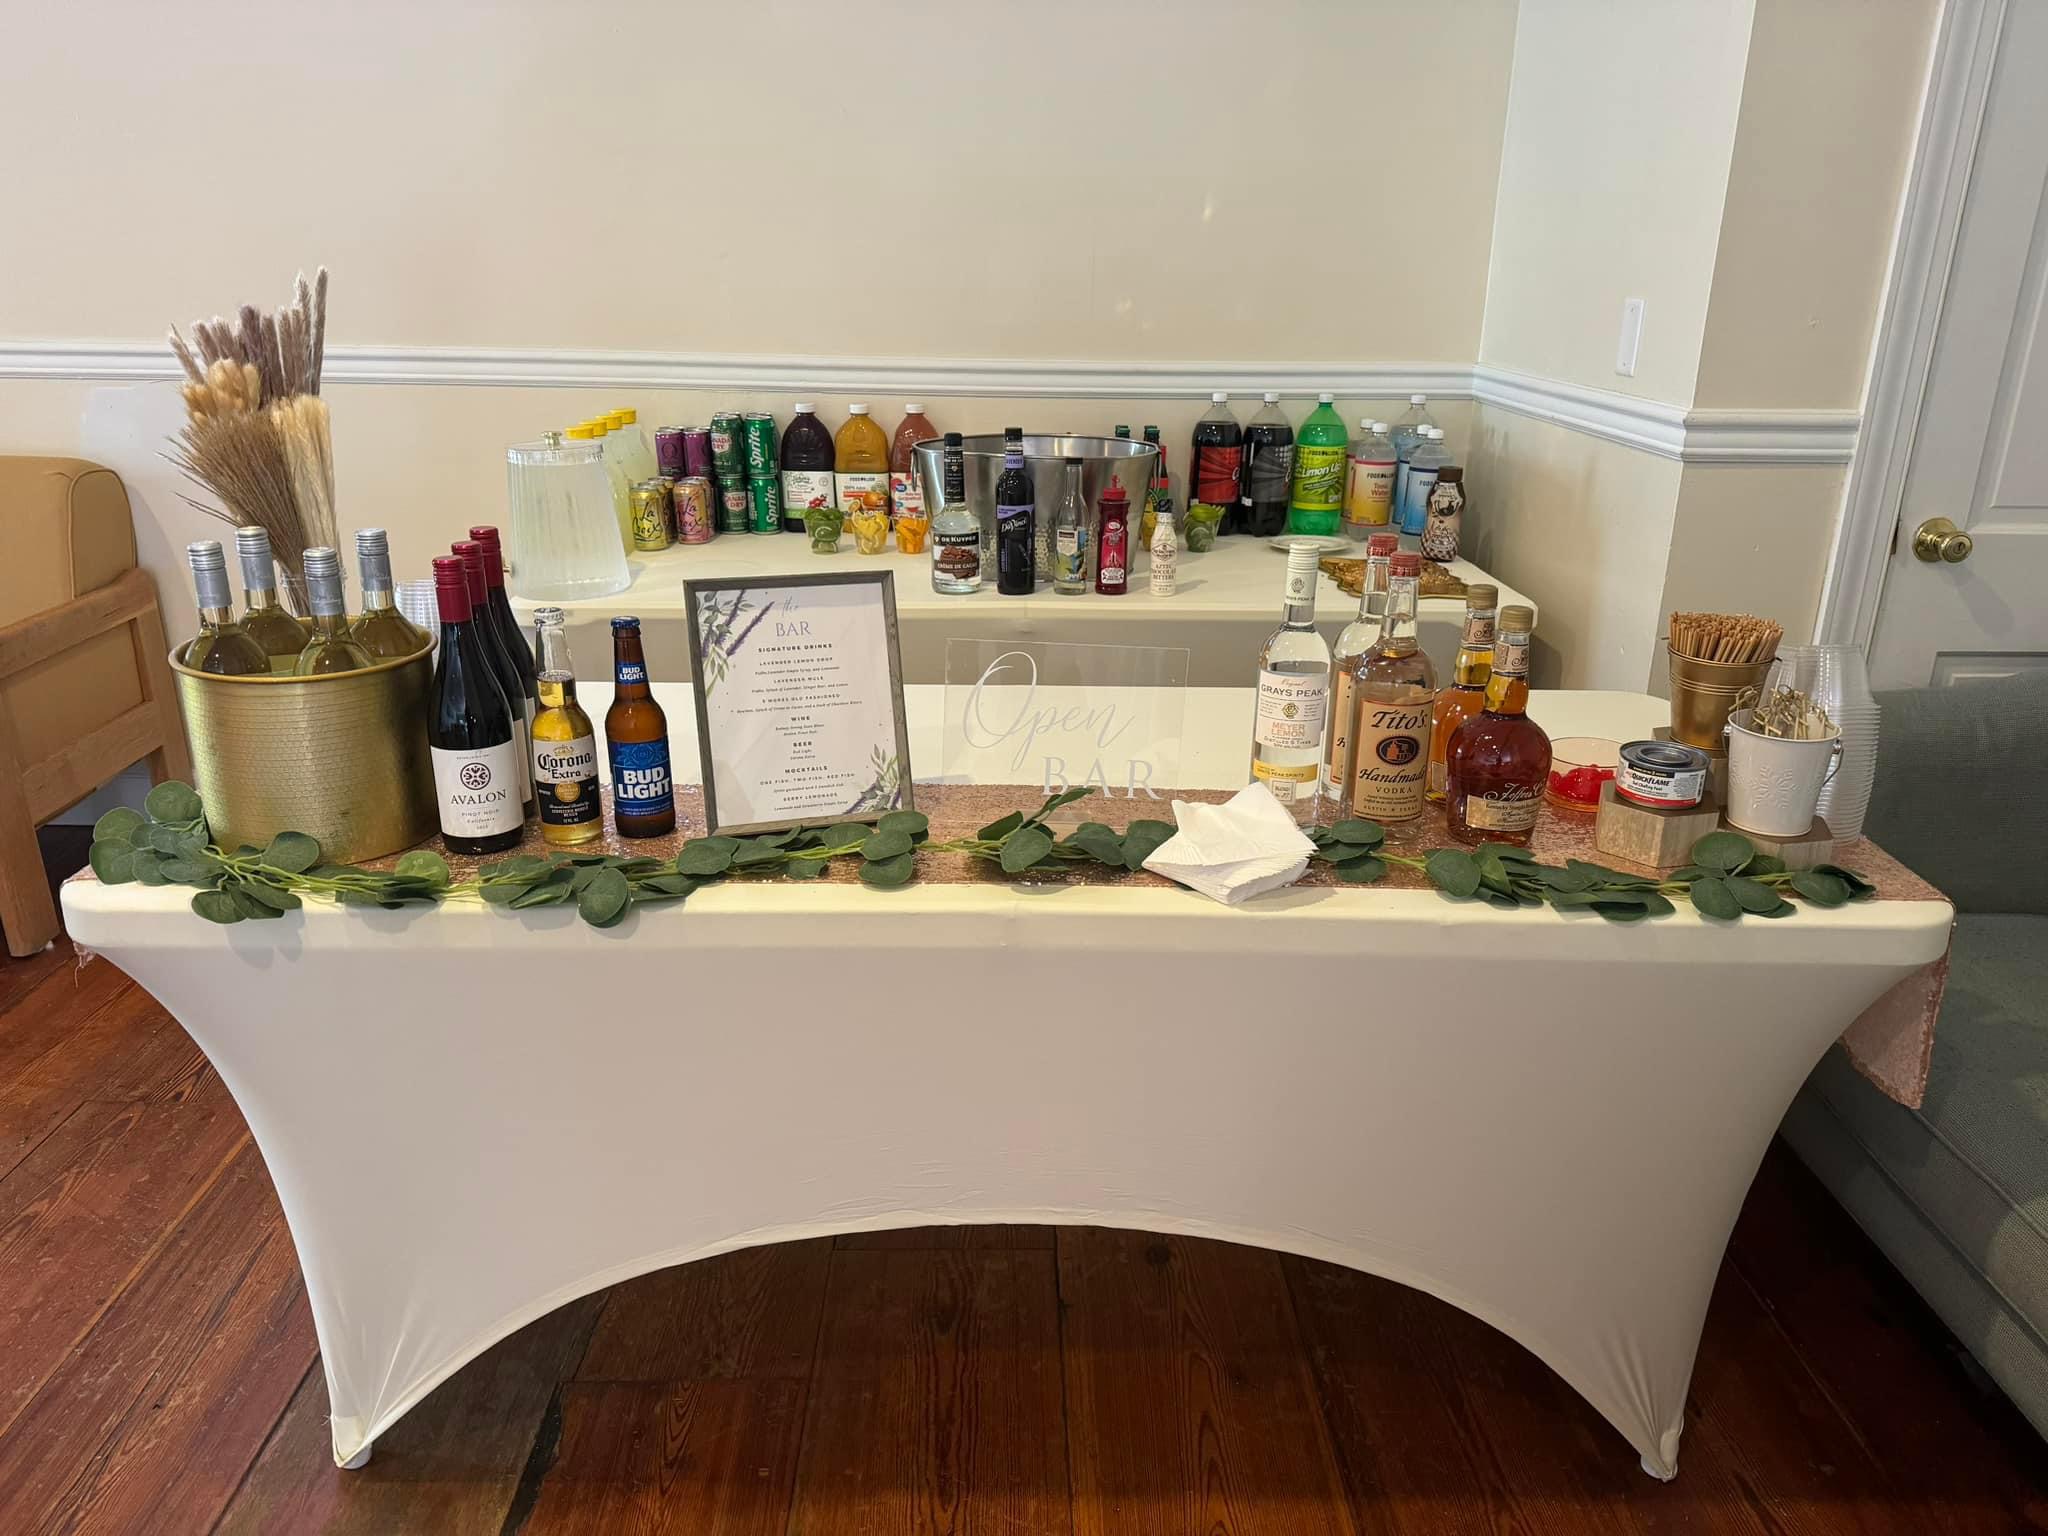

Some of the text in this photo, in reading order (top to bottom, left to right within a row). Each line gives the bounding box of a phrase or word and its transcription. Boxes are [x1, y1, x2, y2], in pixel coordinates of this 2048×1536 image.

[749, 427, 765, 468] Sprite
[766, 486, 781, 525] Sprite
[776, 620, 811, 637] BAR
[758, 645, 802, 653] SIGNATURE
[619, 671, 647, 682] LIGHT
[622, 667, 642, 675] BUD
[1261, 683, 1323, 698] GRAYS PEAK
[964, 651, 1136, 772] Open
[1273, 722, 1305, 731] MEYER
[1371, 710, 1428, 730] Tito's
[1272, 730, 1305, 738] LEMON
[537, 752, 593, 774] Corona
[785, 765, 828, 774] MOCKTAILS
[551, 769, 581, 779] Extra
[623, 766, 665, 785] BUD
[1041, 757, 1165, 800] BAR
[450, 789, 507, 805] AVALON
[618, 779, 671, 799] LIGHT
[1376, 785, 1413, 795] VODKA
